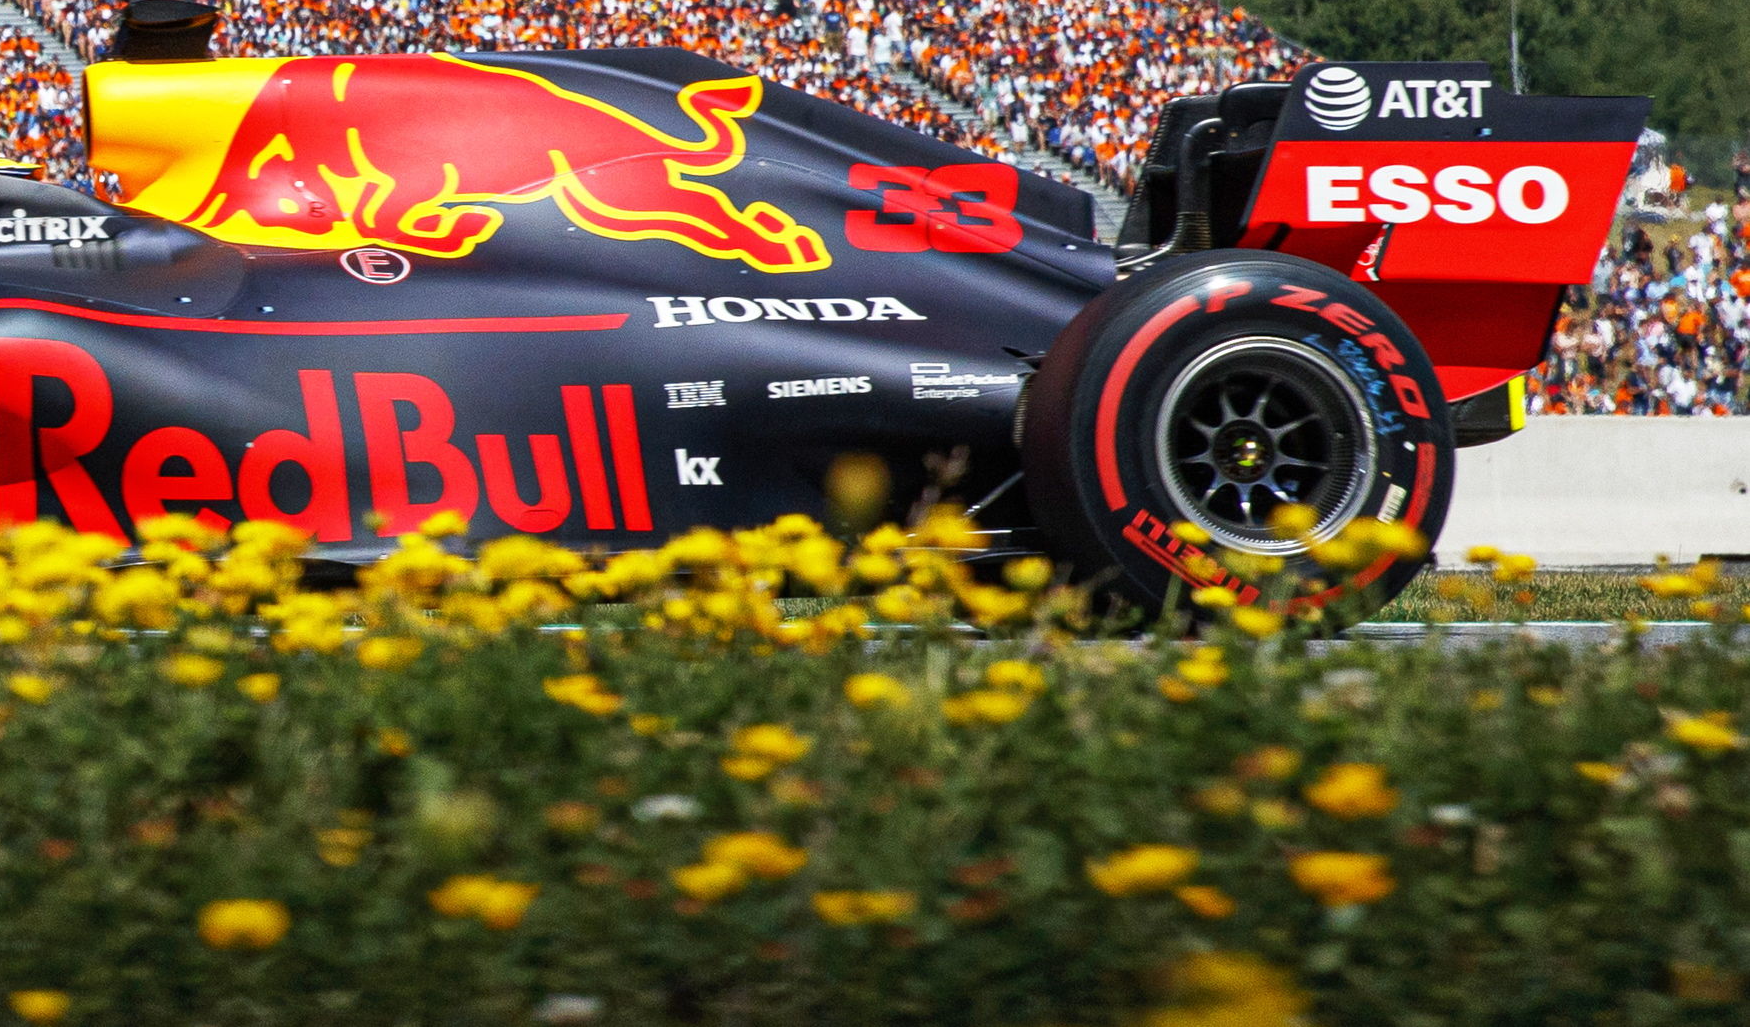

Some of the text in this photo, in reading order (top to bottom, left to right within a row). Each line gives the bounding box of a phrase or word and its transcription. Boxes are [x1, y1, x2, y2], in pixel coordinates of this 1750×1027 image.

[1378, 80, 1492, 119] AT&T
[845, 162, 1025, 254] 33
[1306, 164, 1570, 224] ESSO
[645, 296, 928, 329] HONDA
[1204, 281, 1251, 314] P
[1269, 284, 1431, 420] ZERO
[664, 380, 727, 409] IBM
[767, 375, 872, 399] SIEMENS
[674, 448, 723, 486] kx
